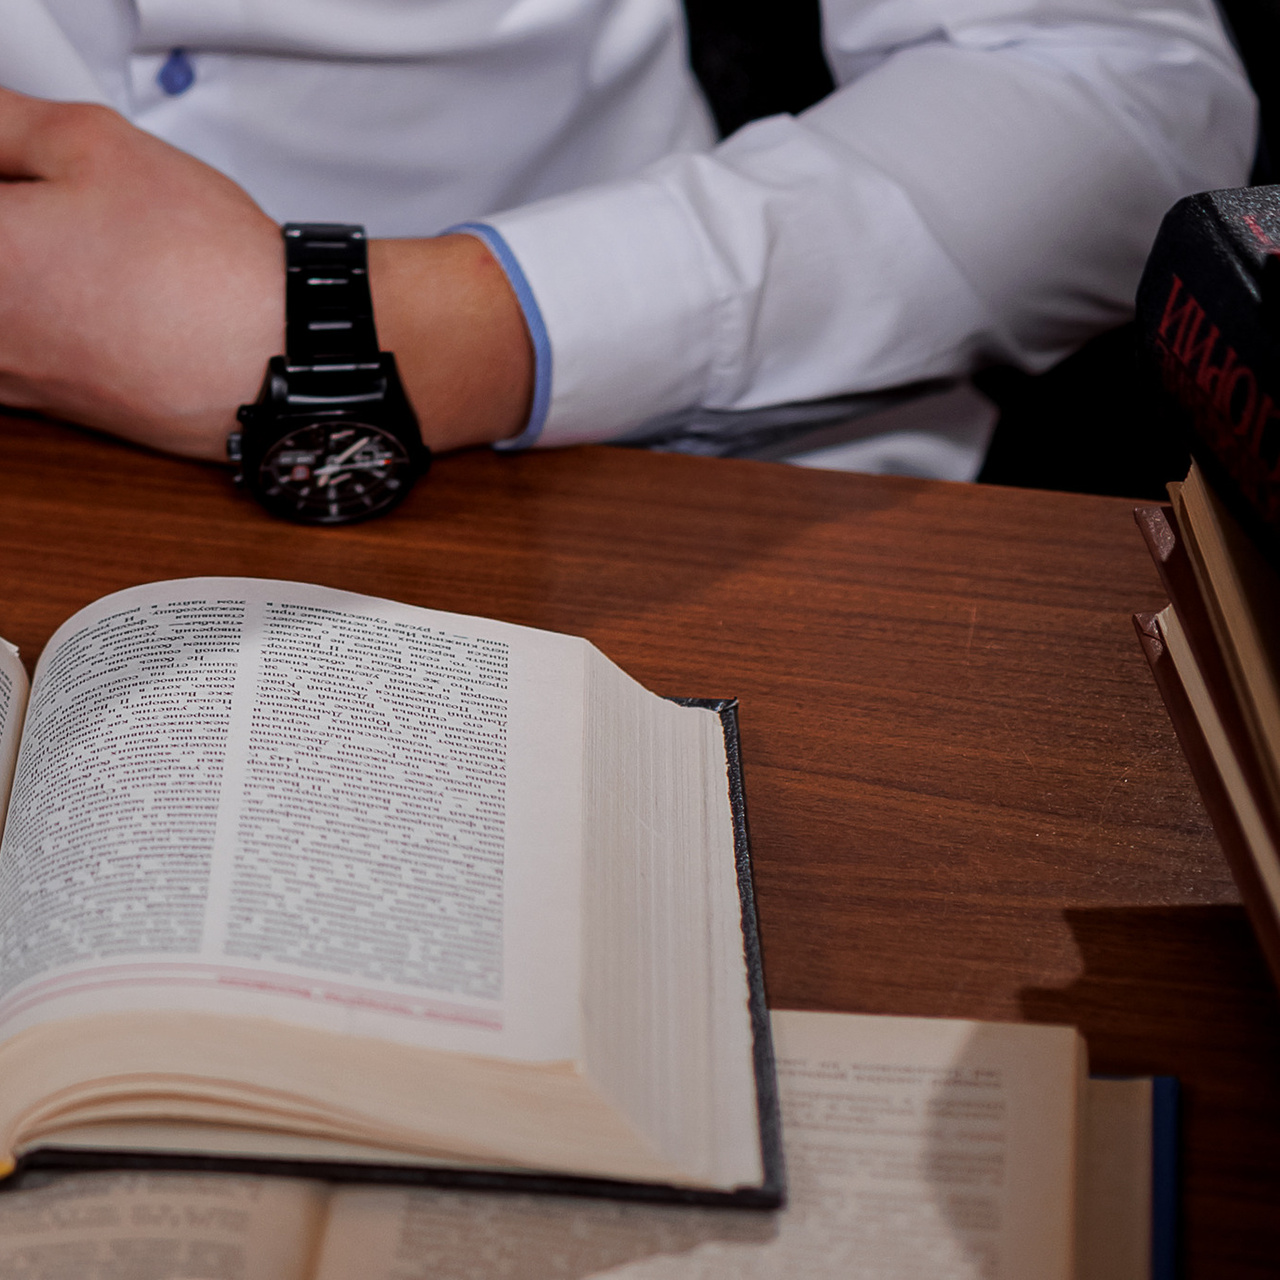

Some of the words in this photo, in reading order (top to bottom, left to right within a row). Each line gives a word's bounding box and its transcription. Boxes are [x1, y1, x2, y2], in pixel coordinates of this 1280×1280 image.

[318, 664, 380, 680] удельных
[309, 677, 368, 692] читатель
[389, 677, 434, 691] козней
[306, 684, 368, 700] Дмитрий
[384, 683, 450, 701] сражений
[460, 691, 508, 705] говоров
[317, 693, 375, 709] Василий
[460, 698, 508, 711] санием
[271, 708, 321, 721] романа
[333, 704, 386, 718] великое
[391, 707, 447, 723] сыновья
[252, 714, 311, 727] чертами
[331, 717, 402, 735] страницах
[350, 714, 391, 728] Юрий
[447, 710, 508, 728] Дмитрий
[462, 721, 484, 729] его
[399, 723, 437, 735] князь
[438, 738, 507, 756] предстают
[444, 732, 508, 749] галицкий
[449, 748, 505, 763] живыми
